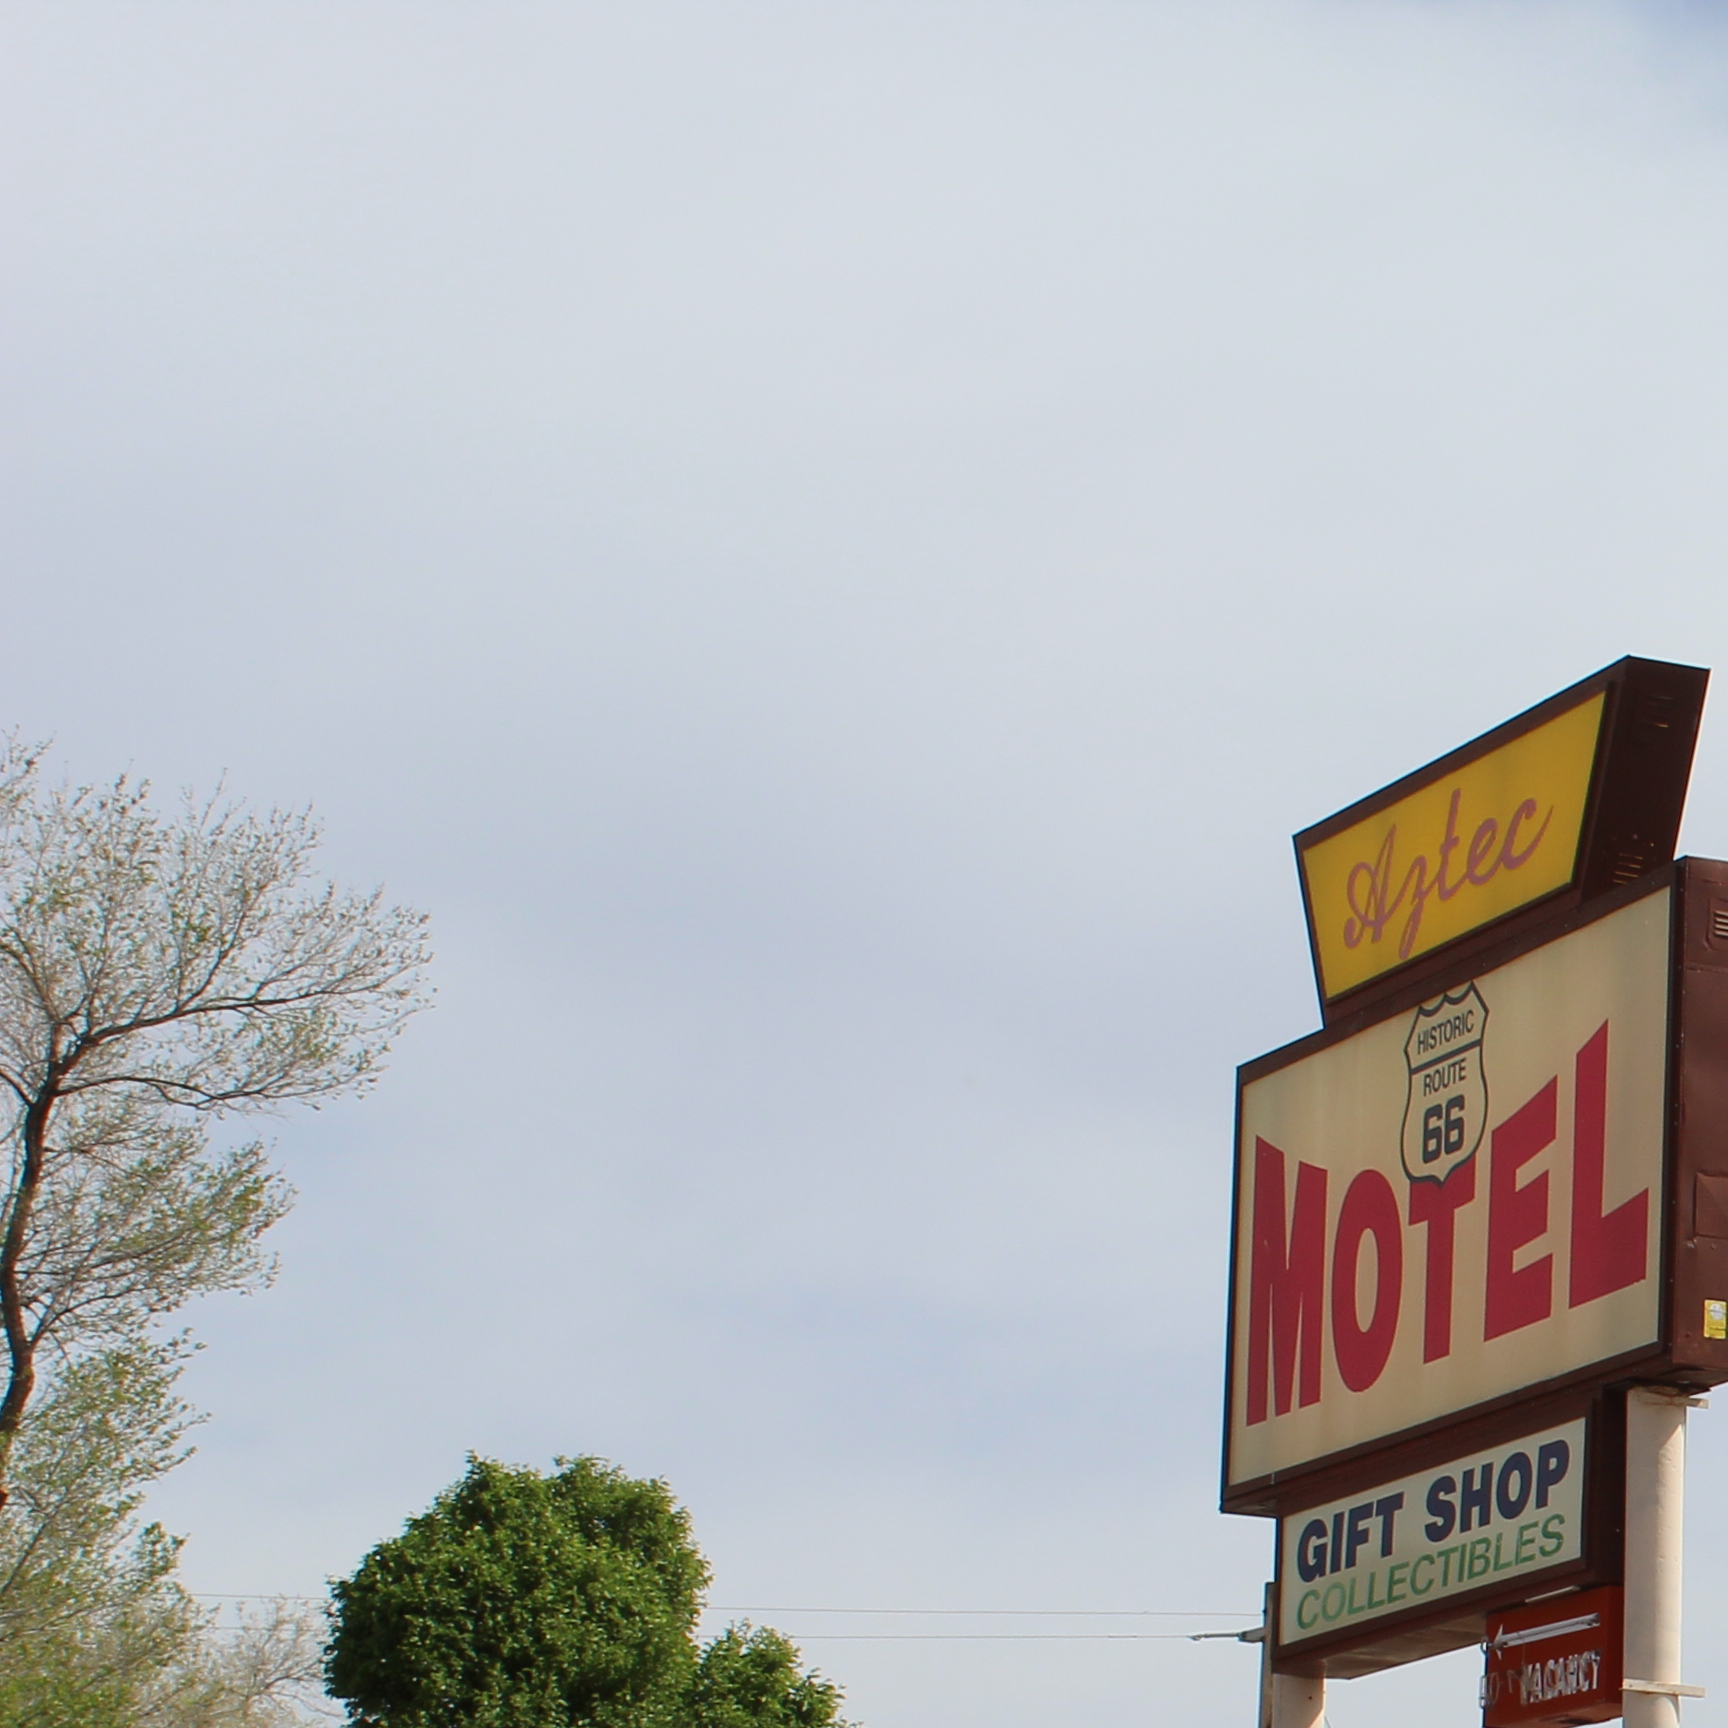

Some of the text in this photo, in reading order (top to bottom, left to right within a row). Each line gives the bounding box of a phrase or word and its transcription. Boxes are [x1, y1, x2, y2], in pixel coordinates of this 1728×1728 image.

[1343, 787, 1554, 961] Aztec
[1417, 1009, 1475, 1055] HISTORIC
[1423, 1056, 1467, 1097] ROUTE
[1422, 1094, 1465, 1164] 66
[1245, 1018, 1649, 1427] MOTEL
[1297, 1438, 1570, 1583] GIFT SHOP
[1296, 1512, 1566, 1631] COLLECTIBLES
[1518, 1648, 1601, 1707] VACANCY
